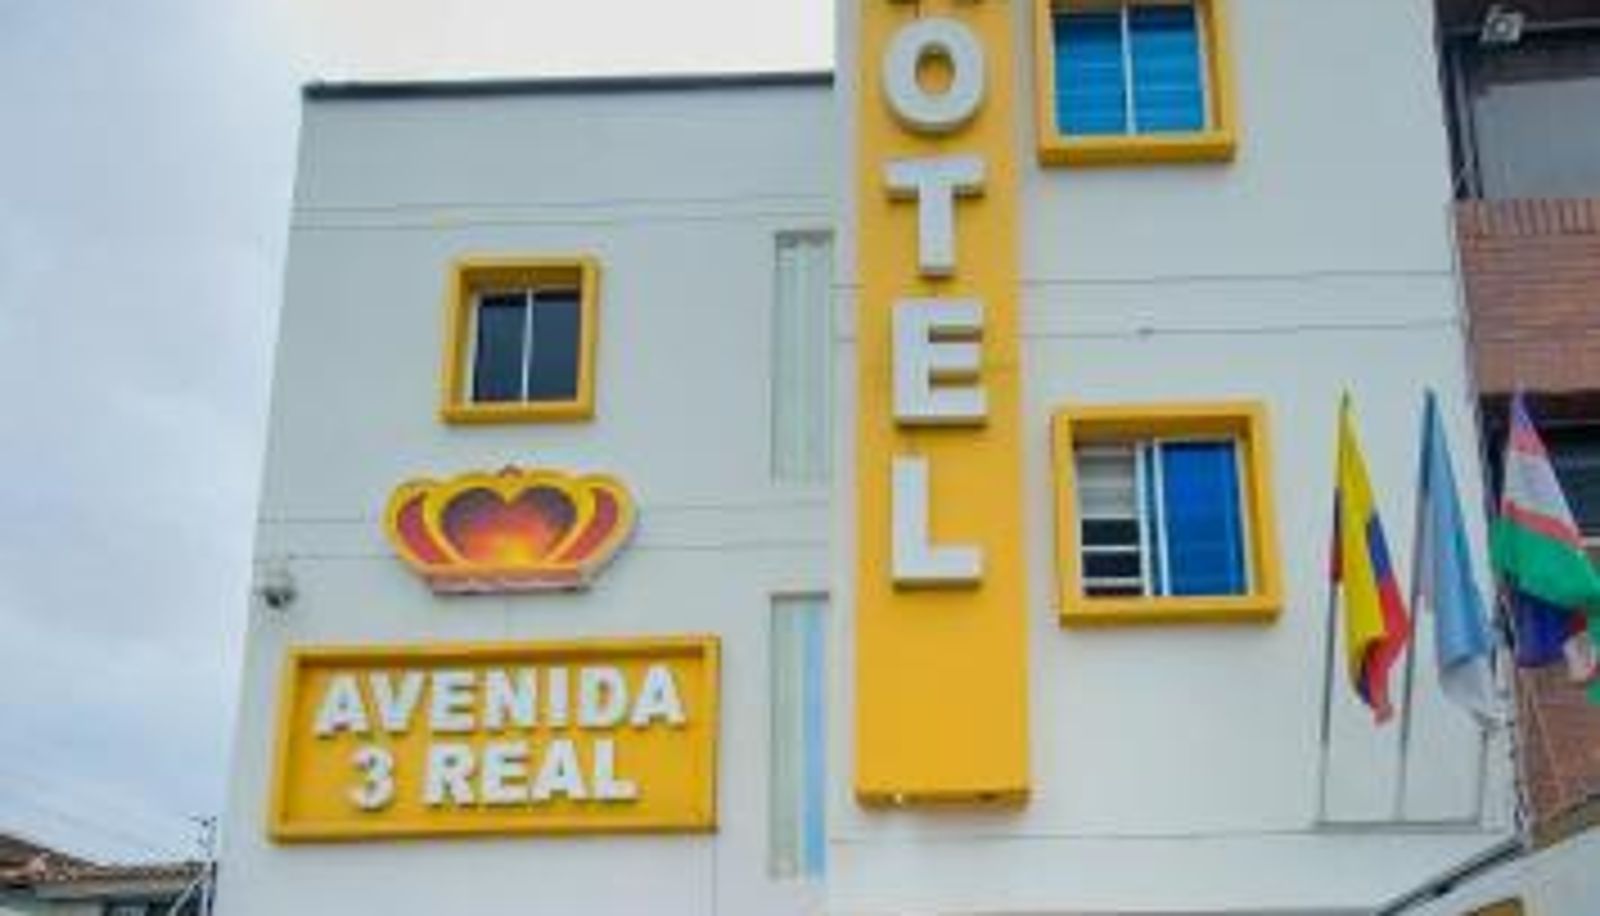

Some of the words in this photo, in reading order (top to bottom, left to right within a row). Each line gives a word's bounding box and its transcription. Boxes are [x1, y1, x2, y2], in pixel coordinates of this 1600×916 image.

[882, 0, 988, 588] OTEL
[314, 664, 686, 737] AVENIDA
[349, 747, 395, 809] 3
[423, 738, 638, 807] REAL
